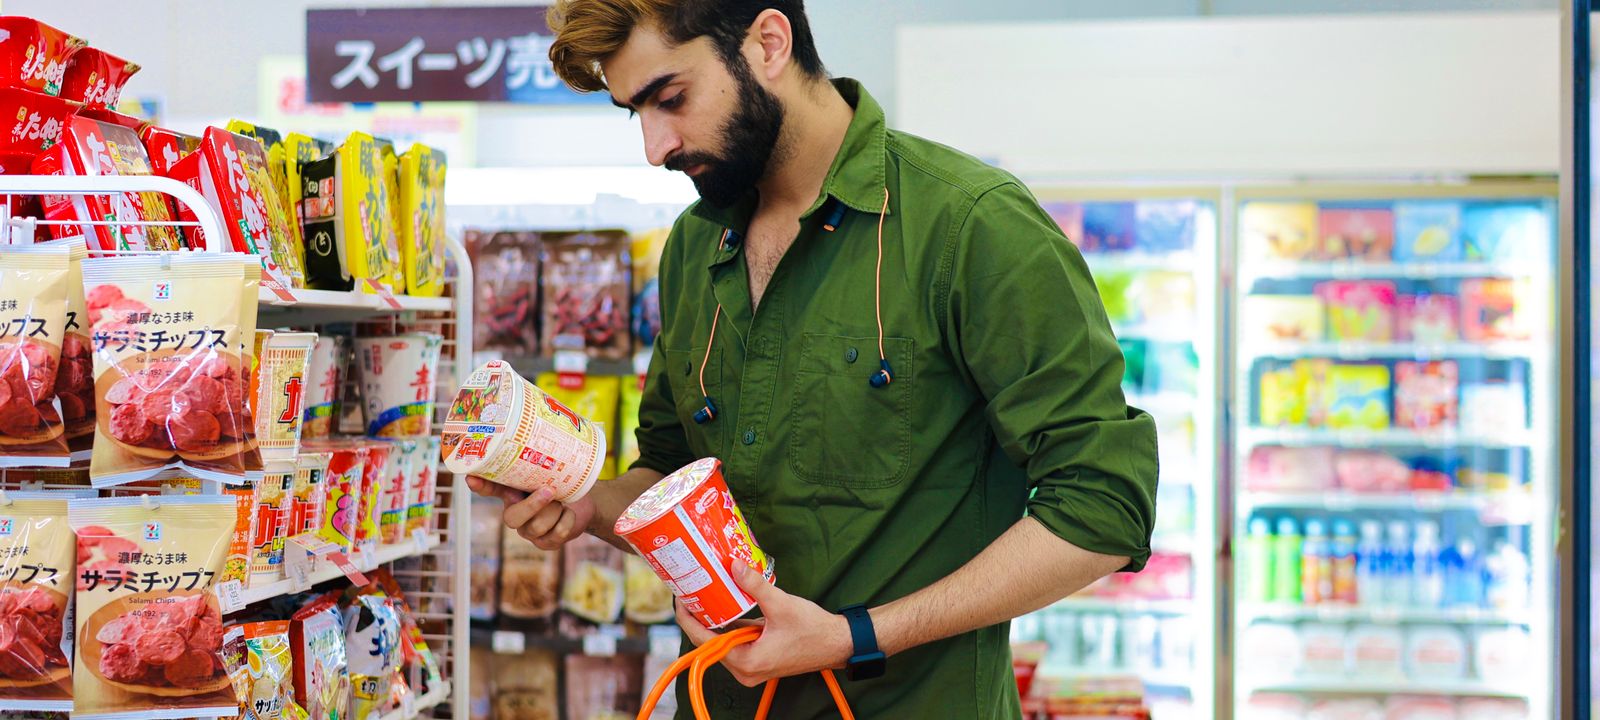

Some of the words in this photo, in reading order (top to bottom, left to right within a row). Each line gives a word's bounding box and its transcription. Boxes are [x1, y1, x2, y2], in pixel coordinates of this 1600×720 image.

[330, 33, 558, 90] スイーツ売
[127, 311, 194, 324] 濃厚なうま味
[92, 325, 228, 353] サラミチップス
[136, 356, 160, 364] Saami
[118, 552, 188, 565] 濃厚なうま味
[0, 563, 58, 585] ップス
[81, 567, 215, 593] サラミチップス
[155, 597, 175, 605] Chips
